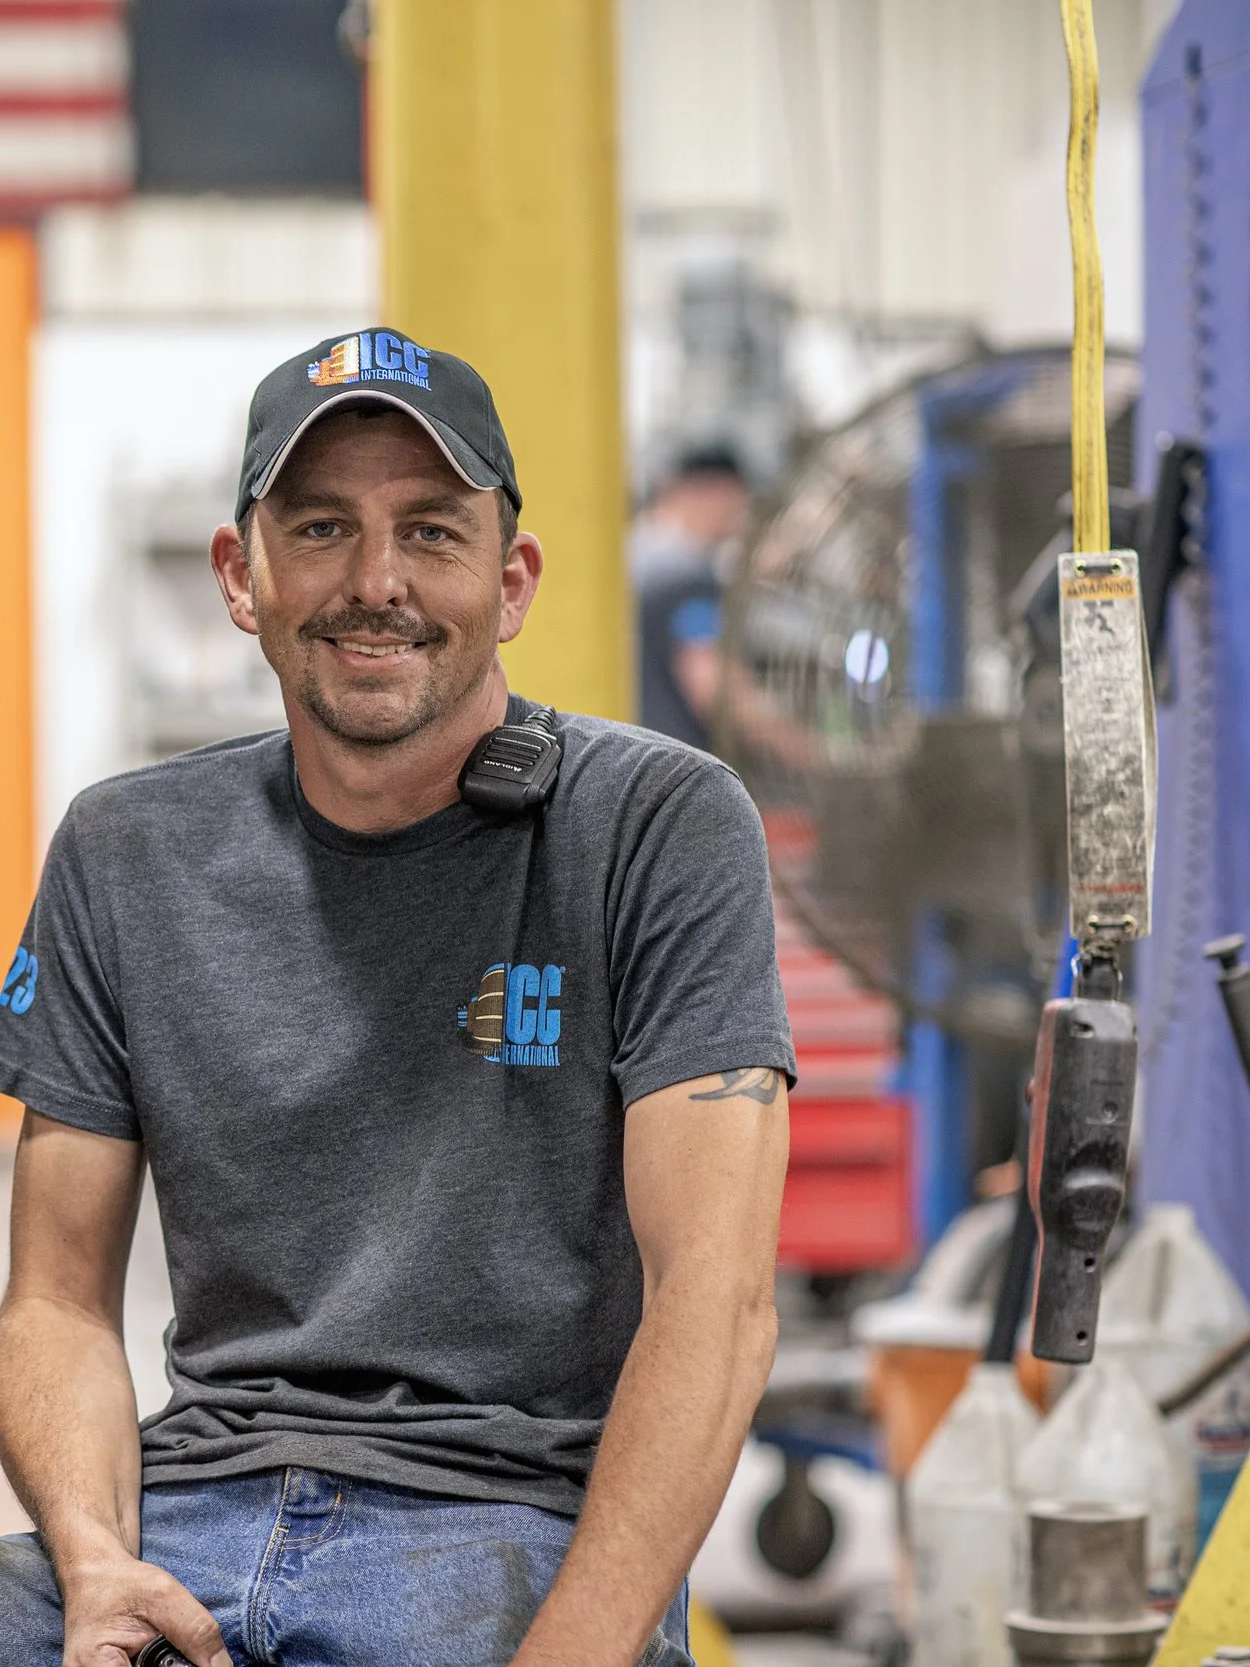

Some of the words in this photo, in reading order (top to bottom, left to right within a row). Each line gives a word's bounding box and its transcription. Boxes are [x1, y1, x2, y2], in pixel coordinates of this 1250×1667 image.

[359, 332, 431, 378] ICC
[361, 369, 432, 391] INTERNATIONAL
[504, 963, 561, 1046] CC
